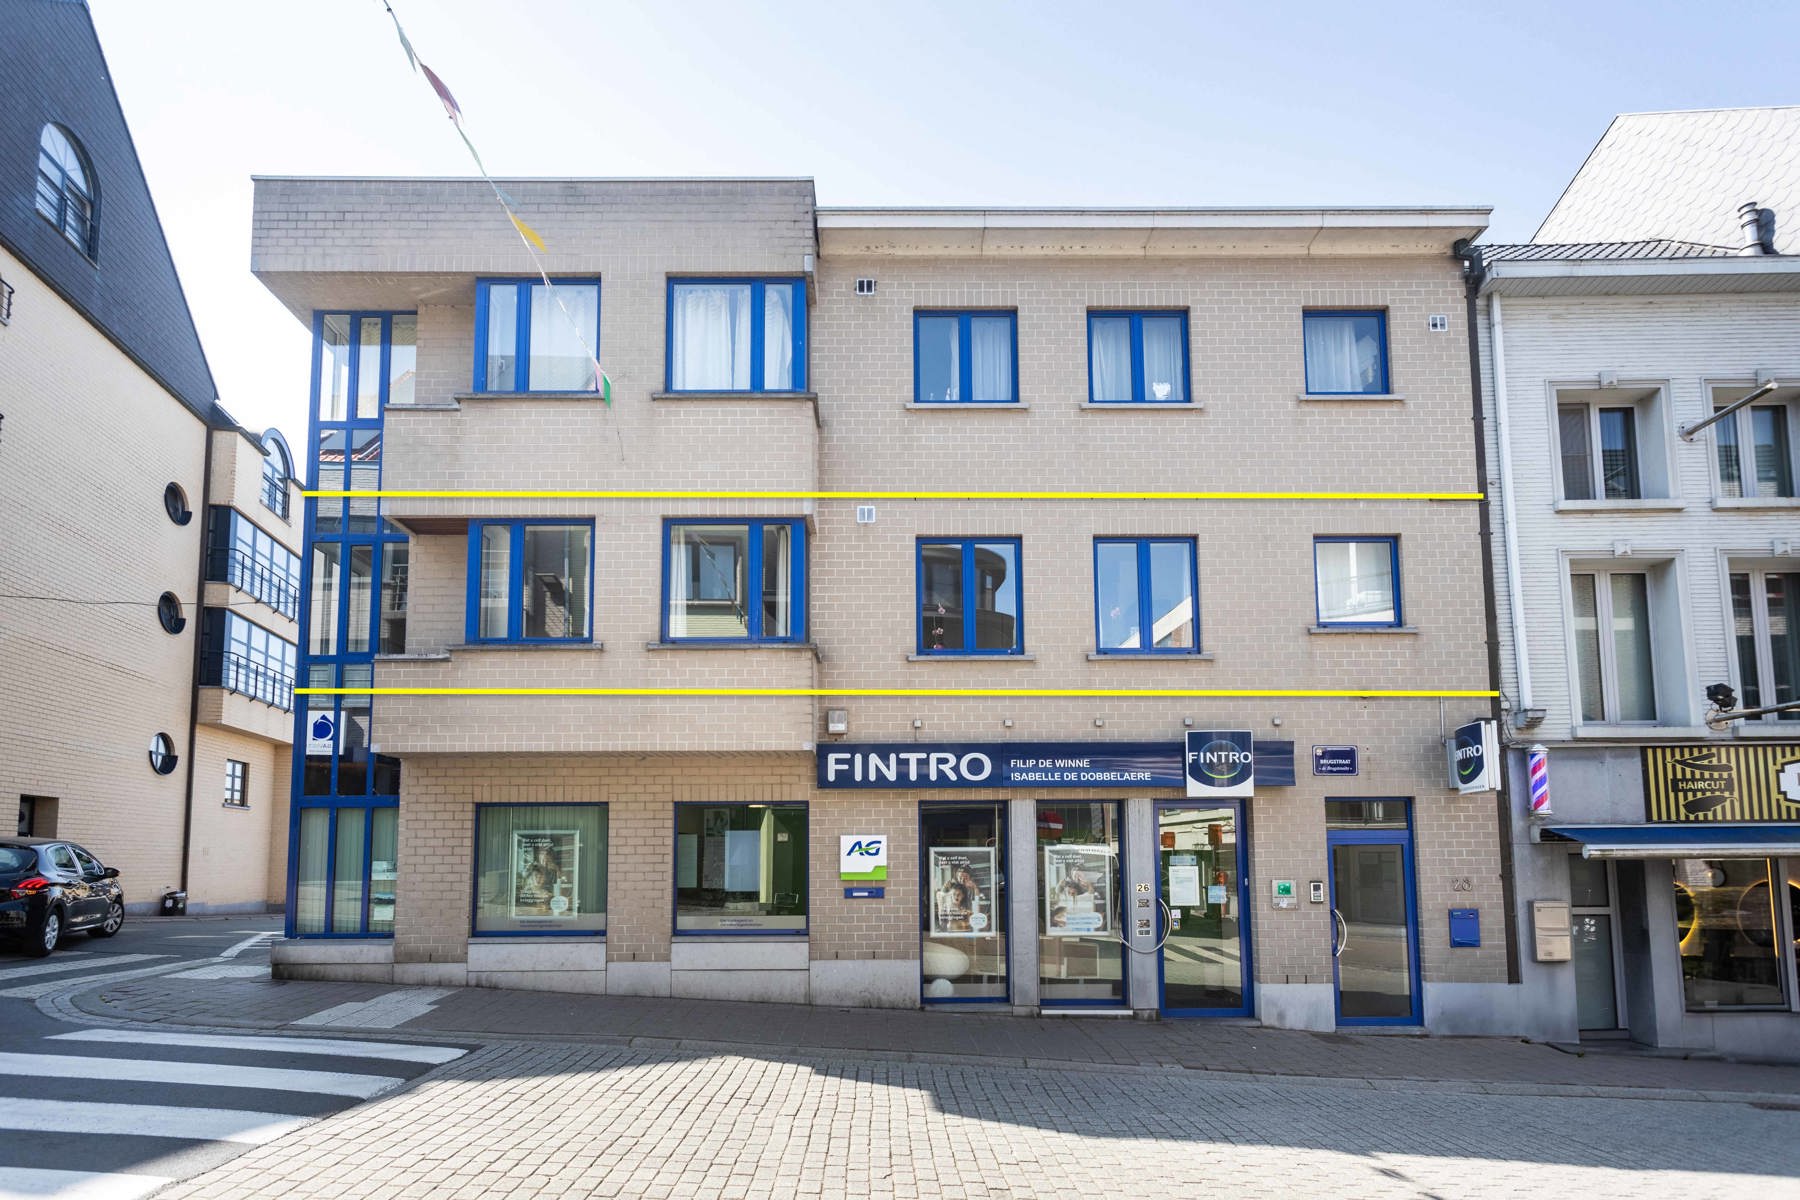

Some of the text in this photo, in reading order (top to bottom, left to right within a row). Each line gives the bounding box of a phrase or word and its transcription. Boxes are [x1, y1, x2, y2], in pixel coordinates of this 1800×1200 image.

[1188, 751, 1252, 764] FINTRO
[827, 752, 992, 782] FINTRO
[1010, 759, 1090, 768] FILIP DE WINNE
[1010, 772, 1152, 781] ISABELLE DE DOBBELAERE
[1678, 780, 1727, 790] HAIRCUT
[846, 840, 882, 856] AG
[1137, 884, 1150, 892] 26
